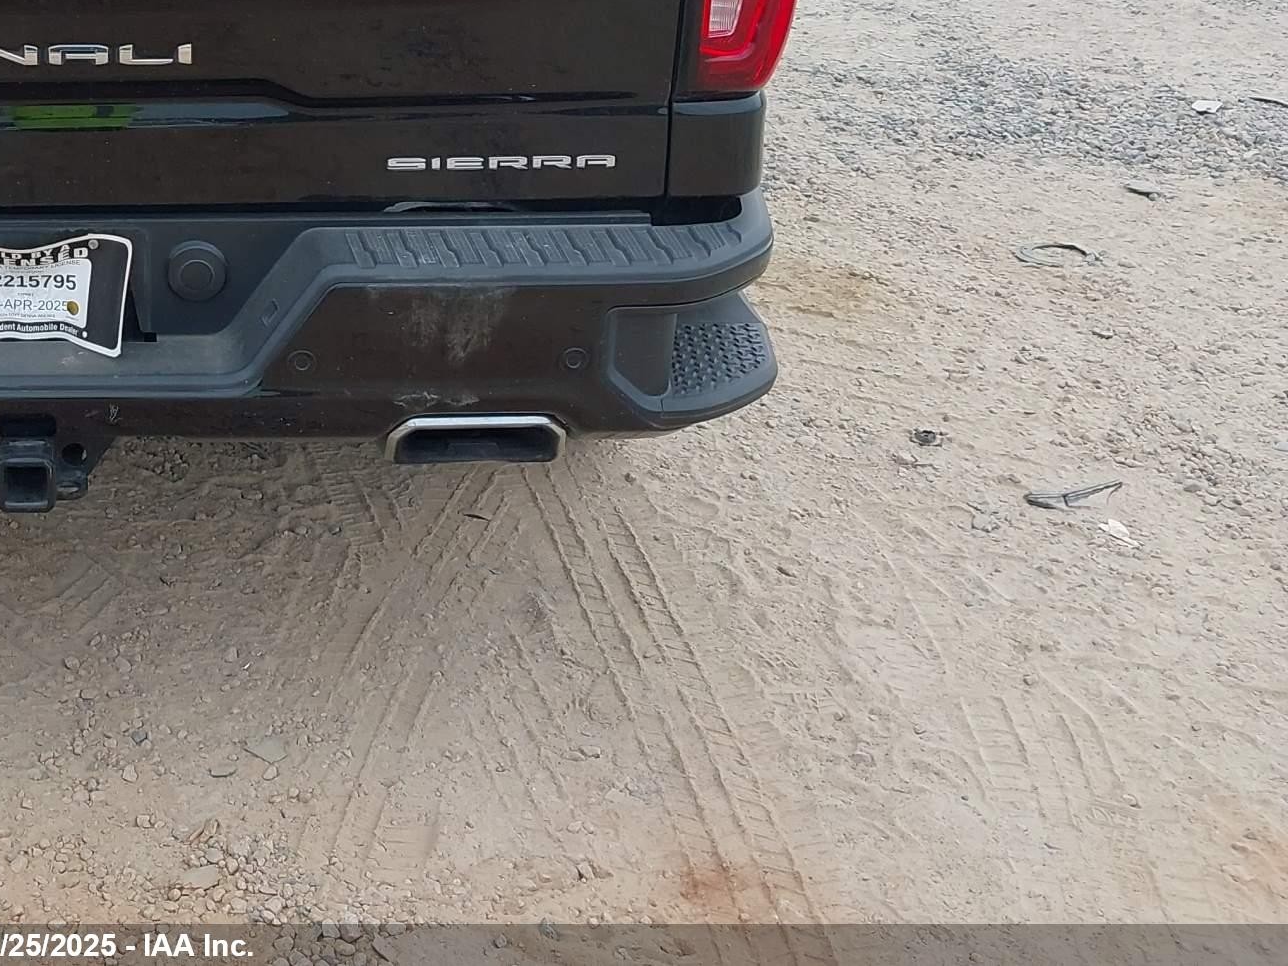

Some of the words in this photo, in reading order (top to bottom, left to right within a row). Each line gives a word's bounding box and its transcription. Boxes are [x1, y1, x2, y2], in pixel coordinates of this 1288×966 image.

[386, 154, 616, 170] SIERRA
[31, 249, 52, 259] BY
[17, 323, 58, 333] Automobile
[59, 324, 79, 336] Dealer
